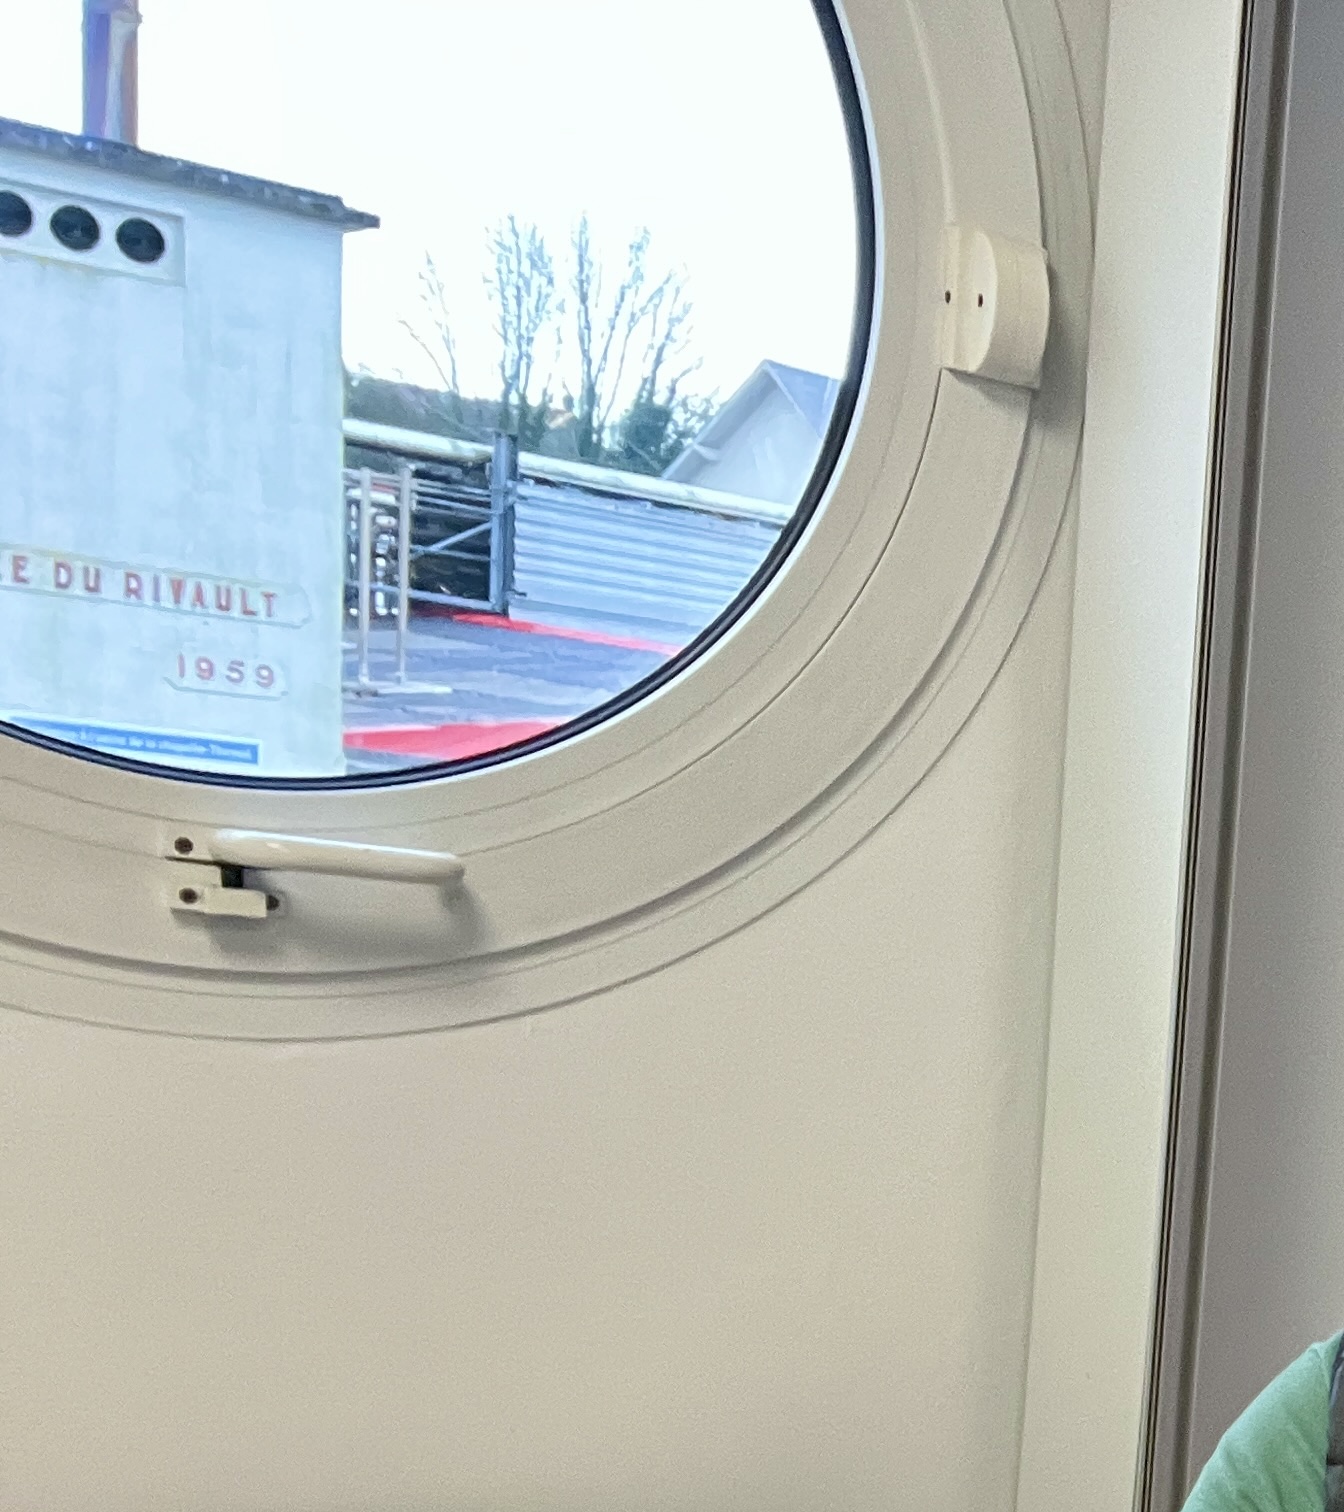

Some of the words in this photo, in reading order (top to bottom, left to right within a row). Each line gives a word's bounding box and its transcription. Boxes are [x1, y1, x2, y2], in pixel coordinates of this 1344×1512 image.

[54, 561, 102, 594] DU
[124, 570, 278, 618] RIVAULT
[176, 651, 276, 689] 1959
